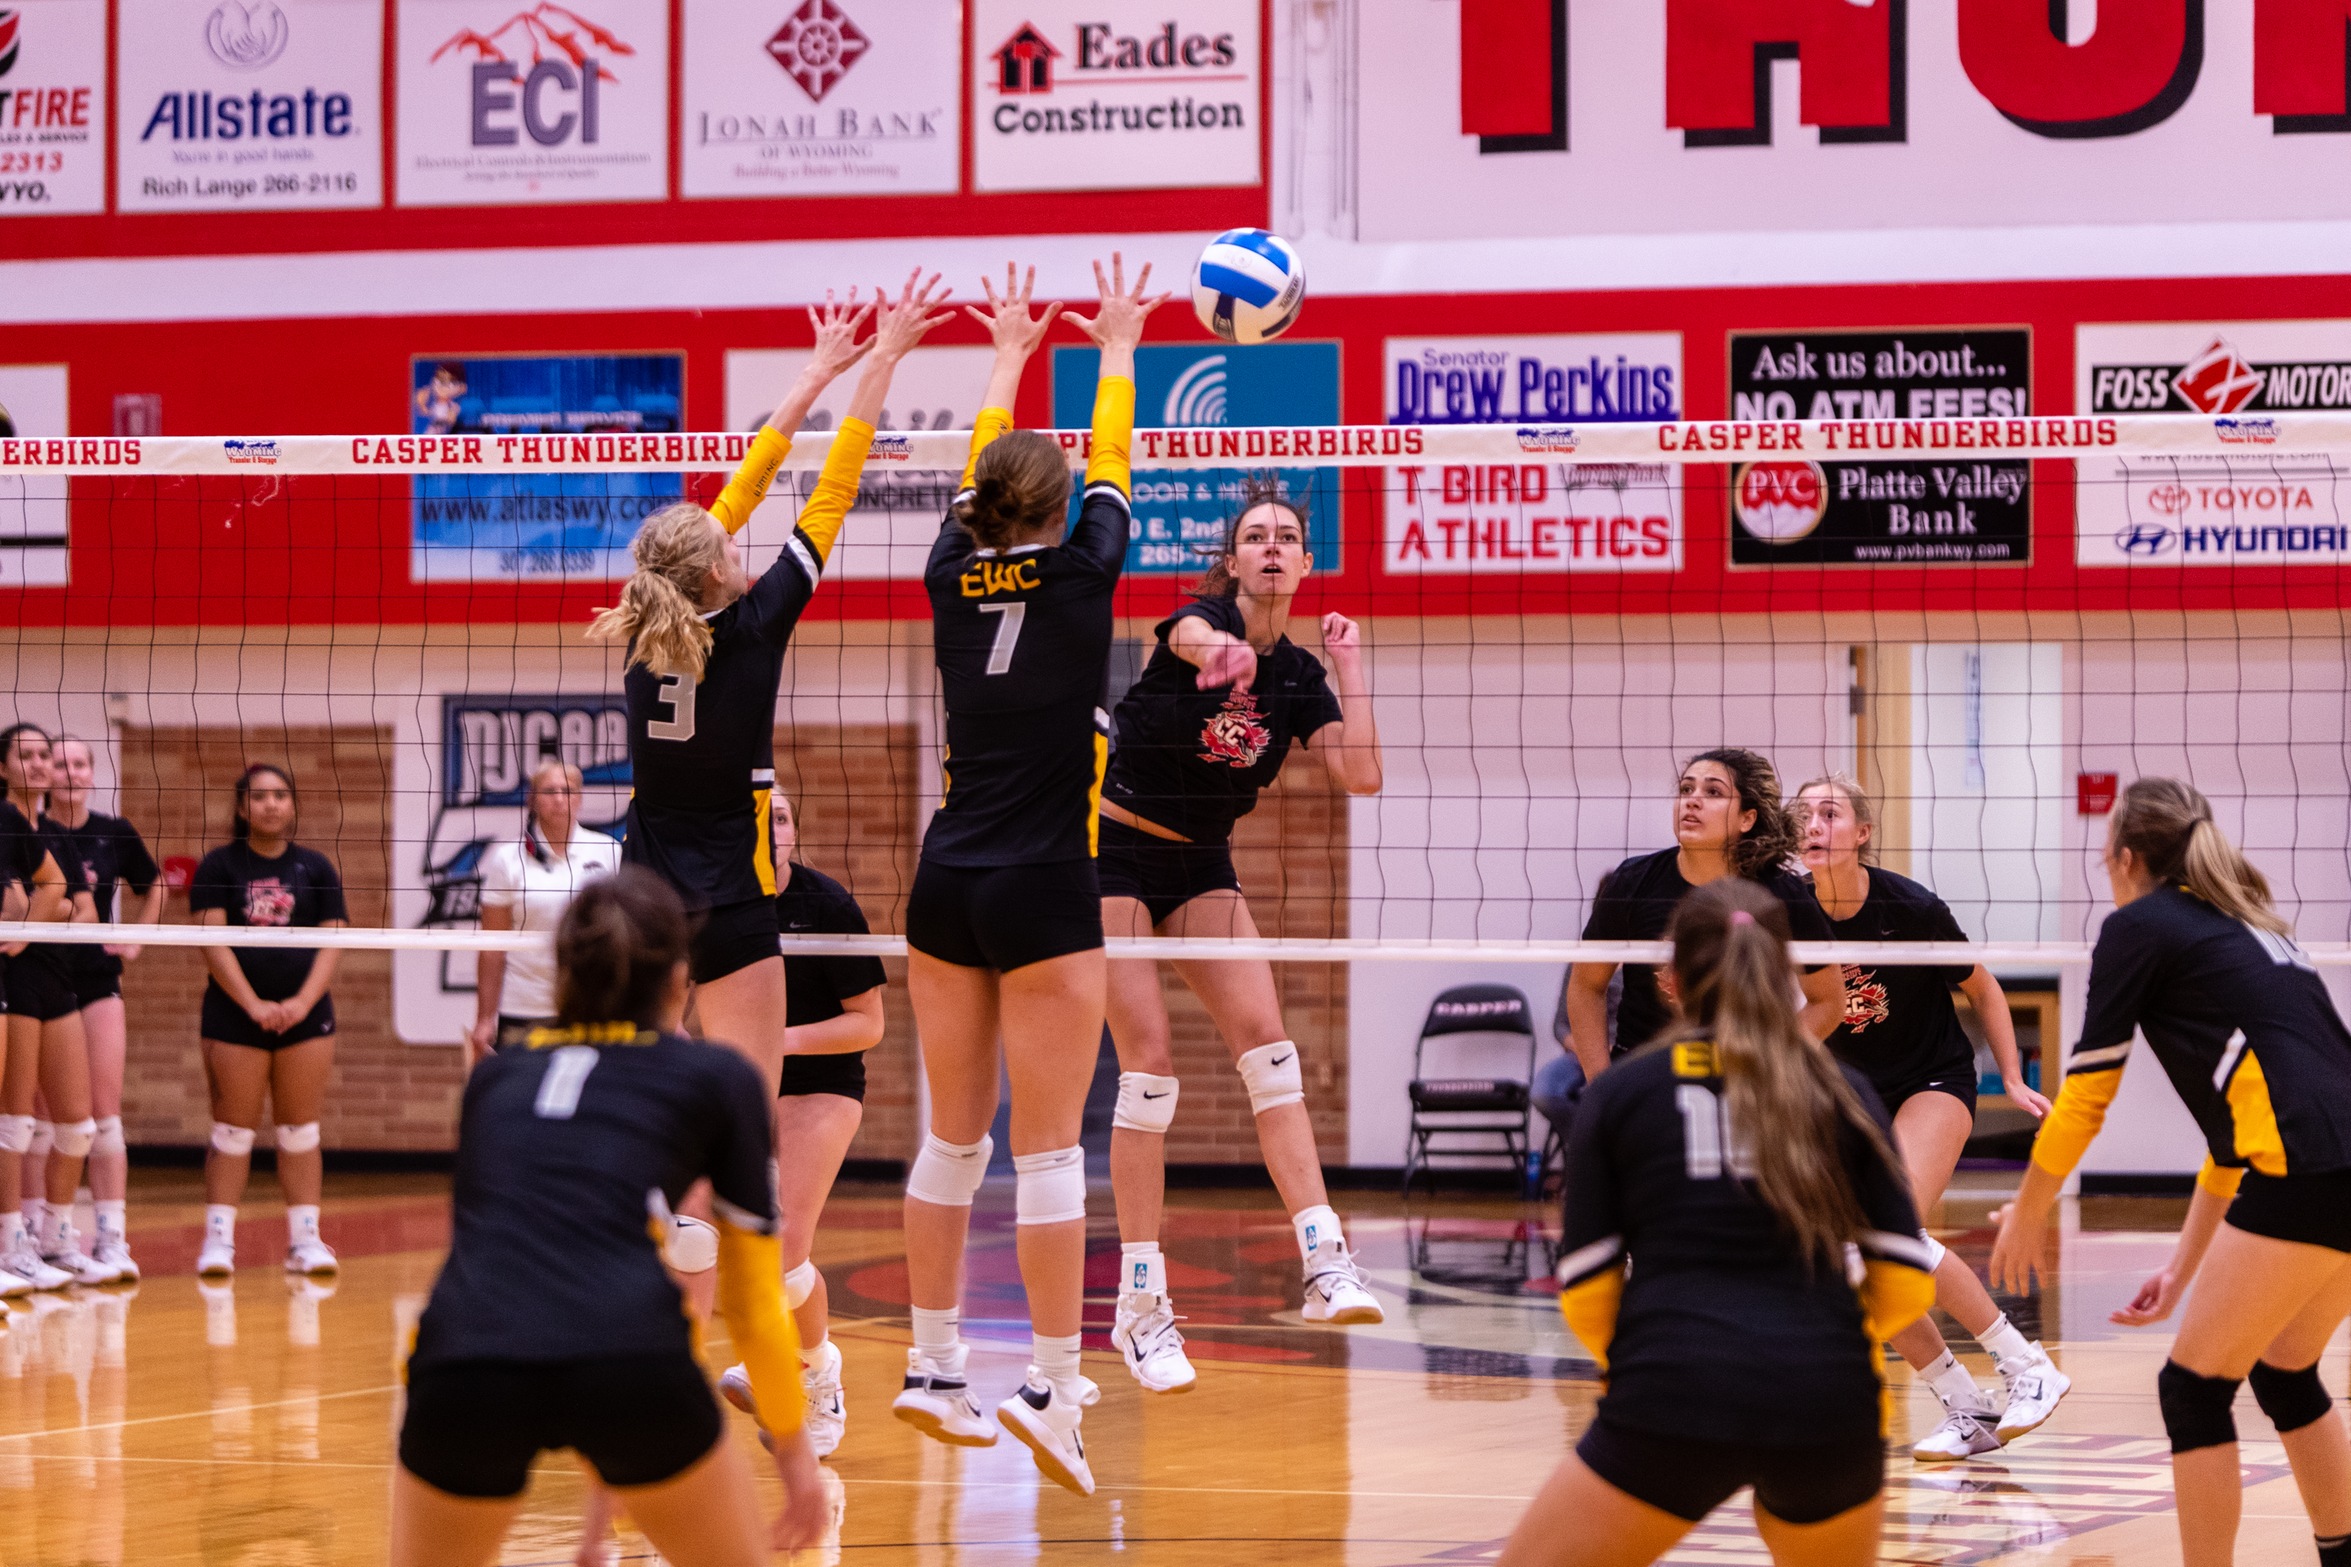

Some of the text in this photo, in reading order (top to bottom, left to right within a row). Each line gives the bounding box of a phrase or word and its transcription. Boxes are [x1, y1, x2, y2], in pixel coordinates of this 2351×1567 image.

[1075, 21, 1236, 70] Eades
[1461, 0, 2351, 152] THU
[141, 87, 353, 142] Allstate
[472, 58, 598, 147] ECI
[993, 97, 1245, 133] Construction
[700, 107, 936, 145] JONAH BANK
[788, 143, 873, 158] WYOMING
[142, 172, 357, 198] Rich Lange 266-2116
[1423, 348, 1511, 367] Senator
[1751, 340, 2007, 381] Ask us about...
[1399, 354, 1674, 418] Drew Perkins
[1733, 387, 2027, 420] NO ATM FEES!
[2095, 368, 2170, 410] FOSS
[2, 439, 141, 465] ERBIRDS
[351, 435, 755, 465] CASPER THUNDERBIRD
[1141, 427, 1425, 458] THUNDERBIRDS
[1658, 418, 2118, 452] CASPER THUNDERBIRDS
[1397, 463, 1549, 504] T-BIRD
[1747, 467, 1817, 500] PVC
[1838, 464, 2026, 506] Platte Valley
[2196, 486, 2314, 511] TOYOTA
[420, 491, 682, 533] www.atlaswy.co
[1147, 516, 1173, 541] E.
[1887, 501, 1978, 536] Bank
[1399, 516, 1671, 561] ATHLETICS
[1854, 541, 2010, 562] www.pvbankwy.com
[2183, 523, 2348, 553] HYUNDAI
[960, 558, 1042, 598] EWC
[978, 600, 1026, 676] 7
[648, 672, 696, 742] 3
